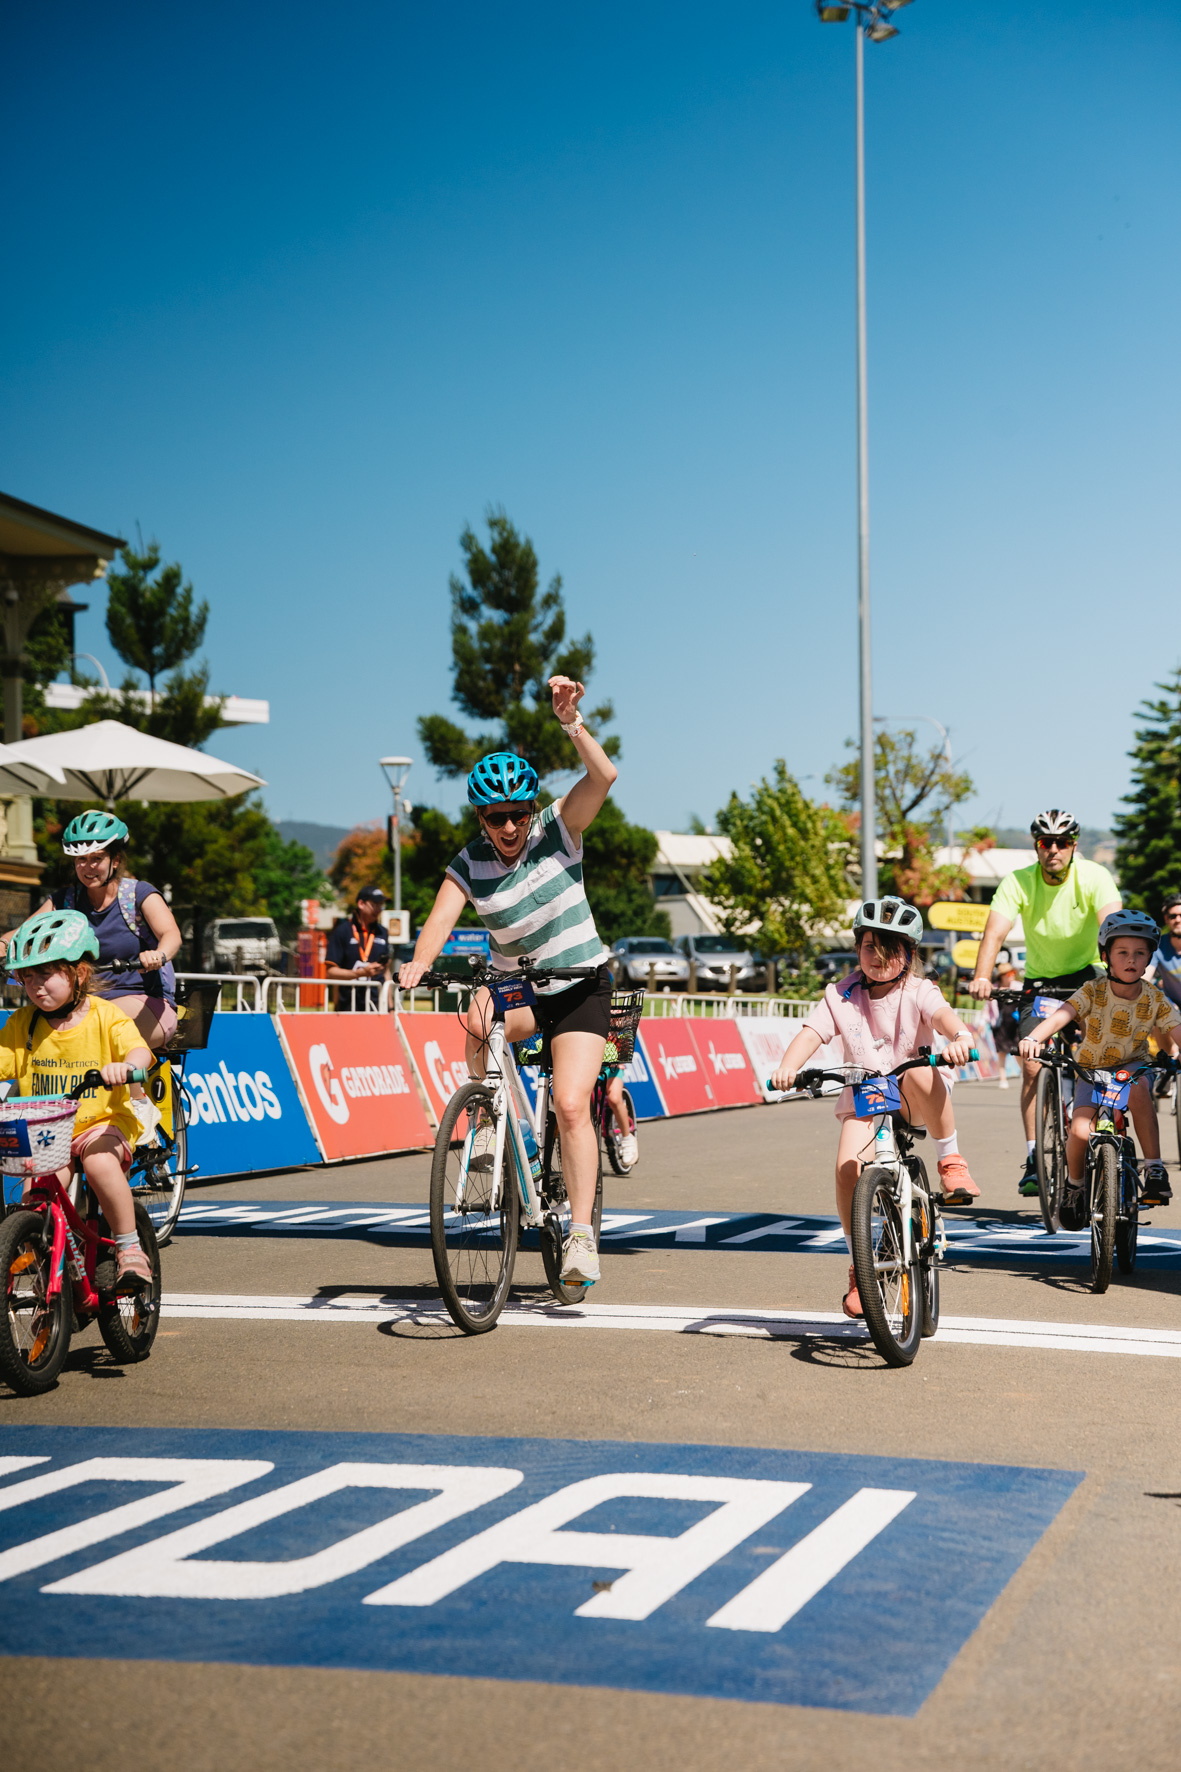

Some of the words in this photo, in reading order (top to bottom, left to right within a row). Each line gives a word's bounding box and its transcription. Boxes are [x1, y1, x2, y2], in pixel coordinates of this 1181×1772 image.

[503, 991, 523, 1002] 73
[32, 1056, 57, 1068] Health
[59, 1058, 99, 1069] Partners
[341, 1065, 410, 1098] GATORADE
[0, 1455, 917, 1633] NDAI
